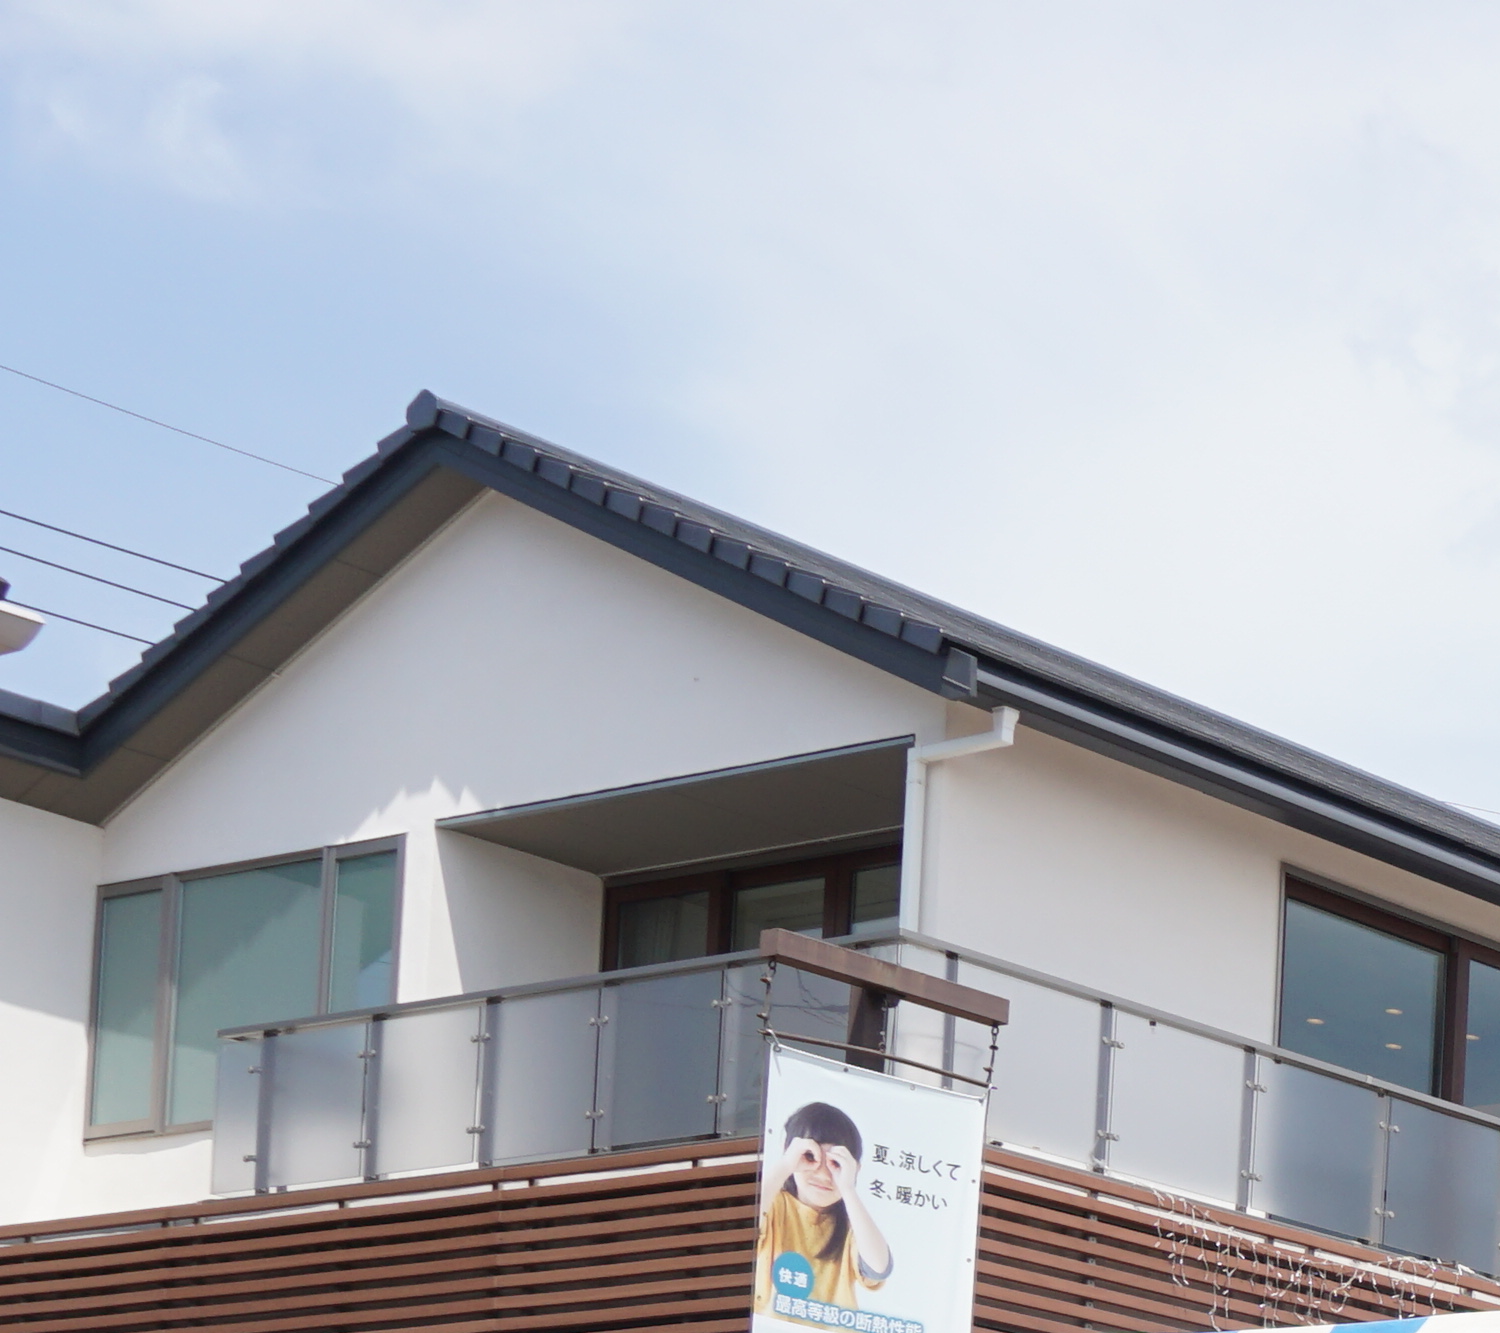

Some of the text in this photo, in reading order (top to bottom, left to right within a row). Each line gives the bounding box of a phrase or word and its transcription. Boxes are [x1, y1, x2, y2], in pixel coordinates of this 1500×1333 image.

[873, 1143, 962, 1181] 夏、涼しくて
[869, 1178, 948, 1211] 冬、暖かい
[778, 1266, 808, 1289] 快適
